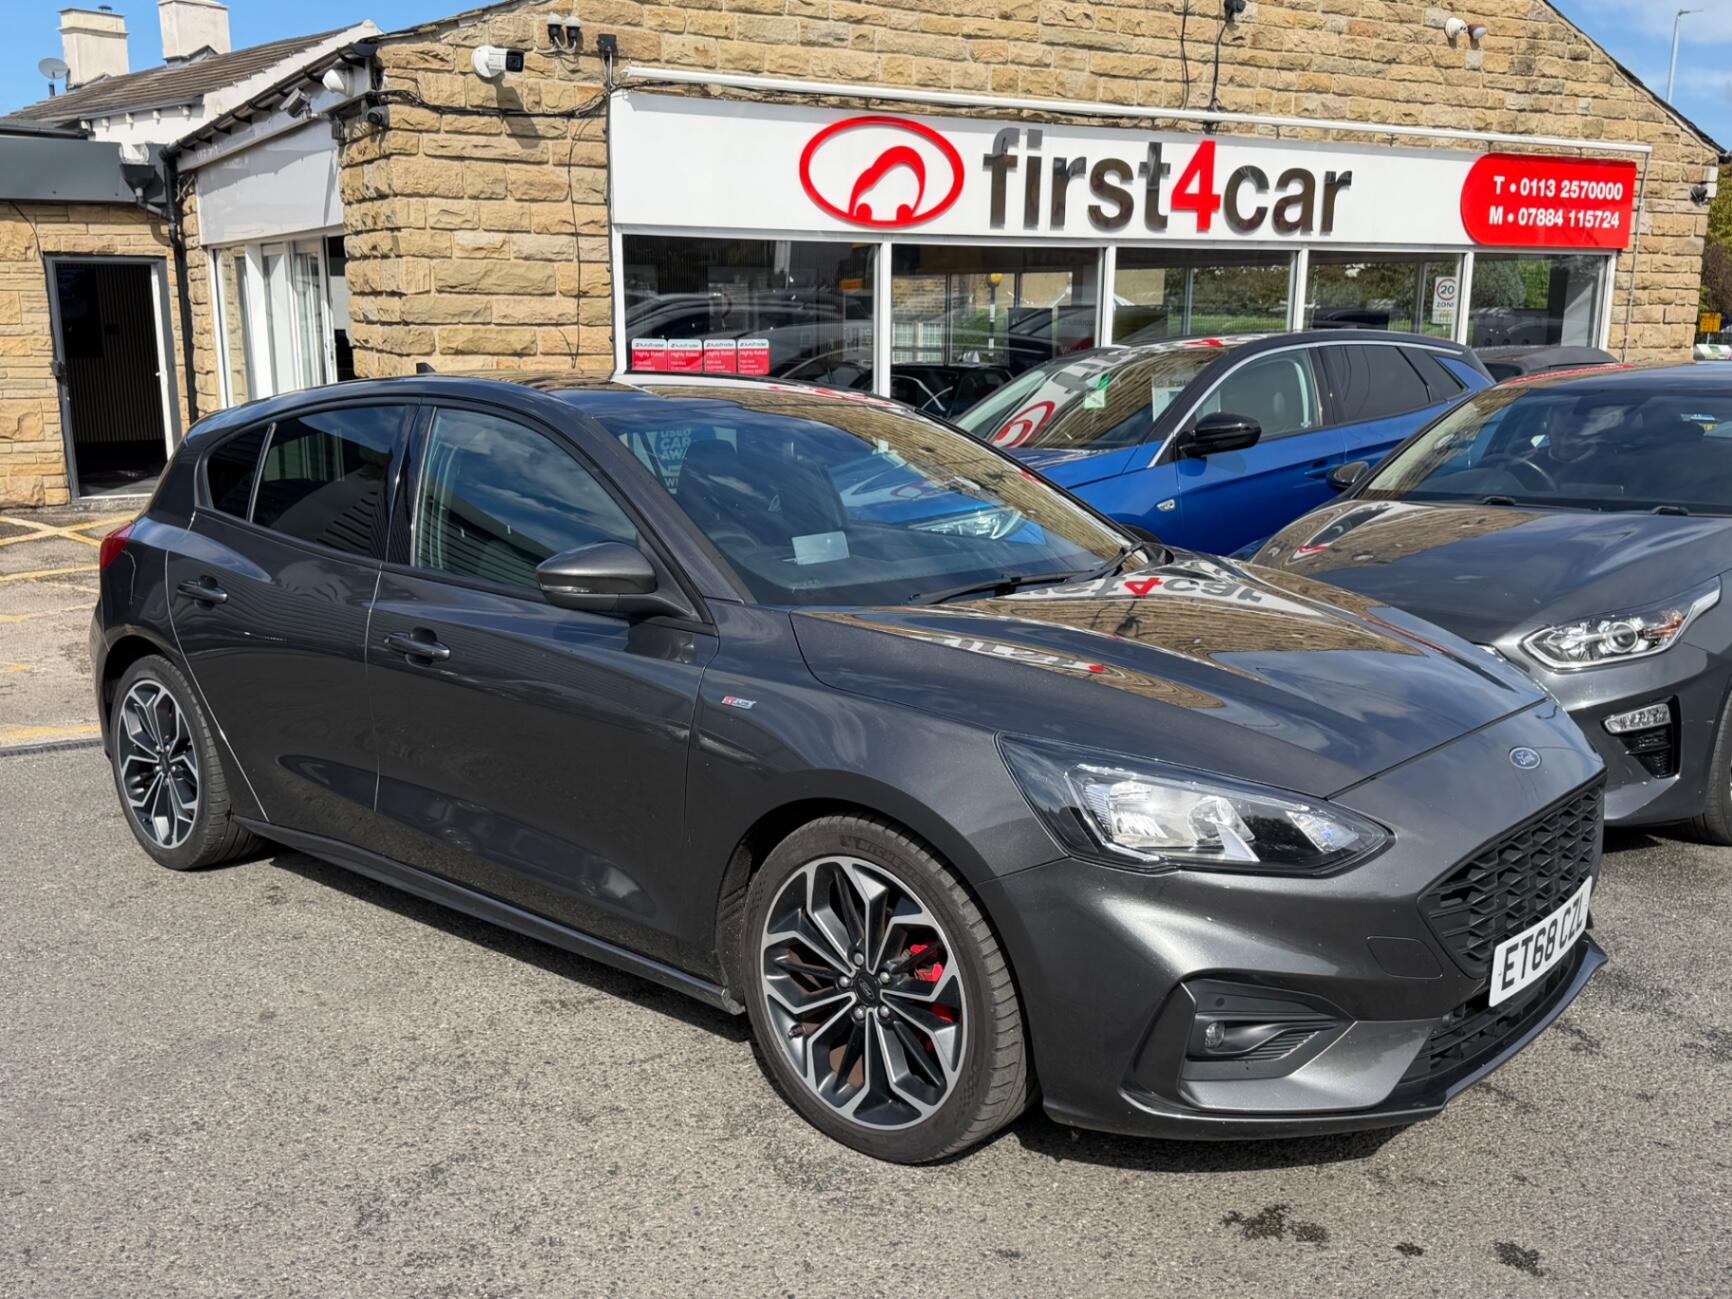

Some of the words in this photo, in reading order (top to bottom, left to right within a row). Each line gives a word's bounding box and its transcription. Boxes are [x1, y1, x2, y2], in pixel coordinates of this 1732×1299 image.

[983, 128, 1352, 236] first4car
[1493, 176, 1505, 195] T
[1520, 178, 1556, 198] 0113
[1560, 180, 1623, 200] 2570000
[1489, 206, 1503, 225] M
[1518, 207, 1564, 227] 07884
[1569, 210, 1620, 229] 115724
[1440, 284, 1455, 295] 20
[1501, 919, 1558, 991] ET68
[1559, 892, 1584, 949] CZL
